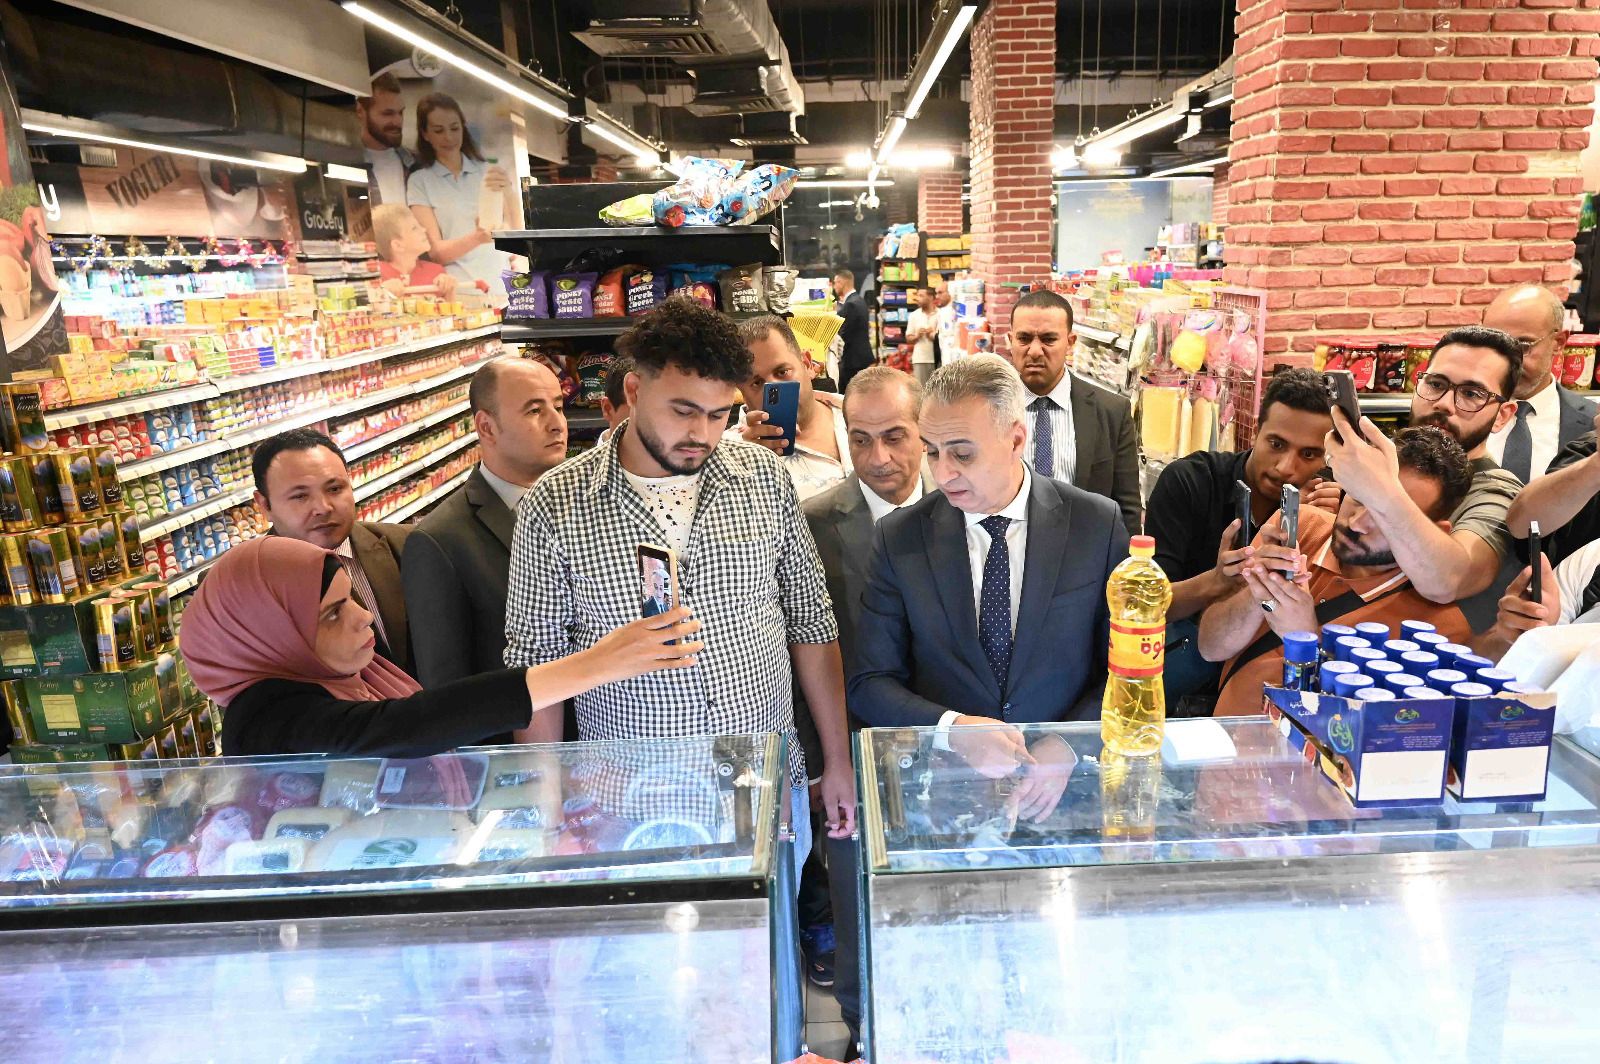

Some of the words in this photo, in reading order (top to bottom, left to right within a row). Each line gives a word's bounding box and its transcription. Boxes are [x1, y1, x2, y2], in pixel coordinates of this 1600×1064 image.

[303, 210, 344, 235] Grocery
[628, 290, 654, 303] Greek
[740, 295, 759, 305] BBQ
